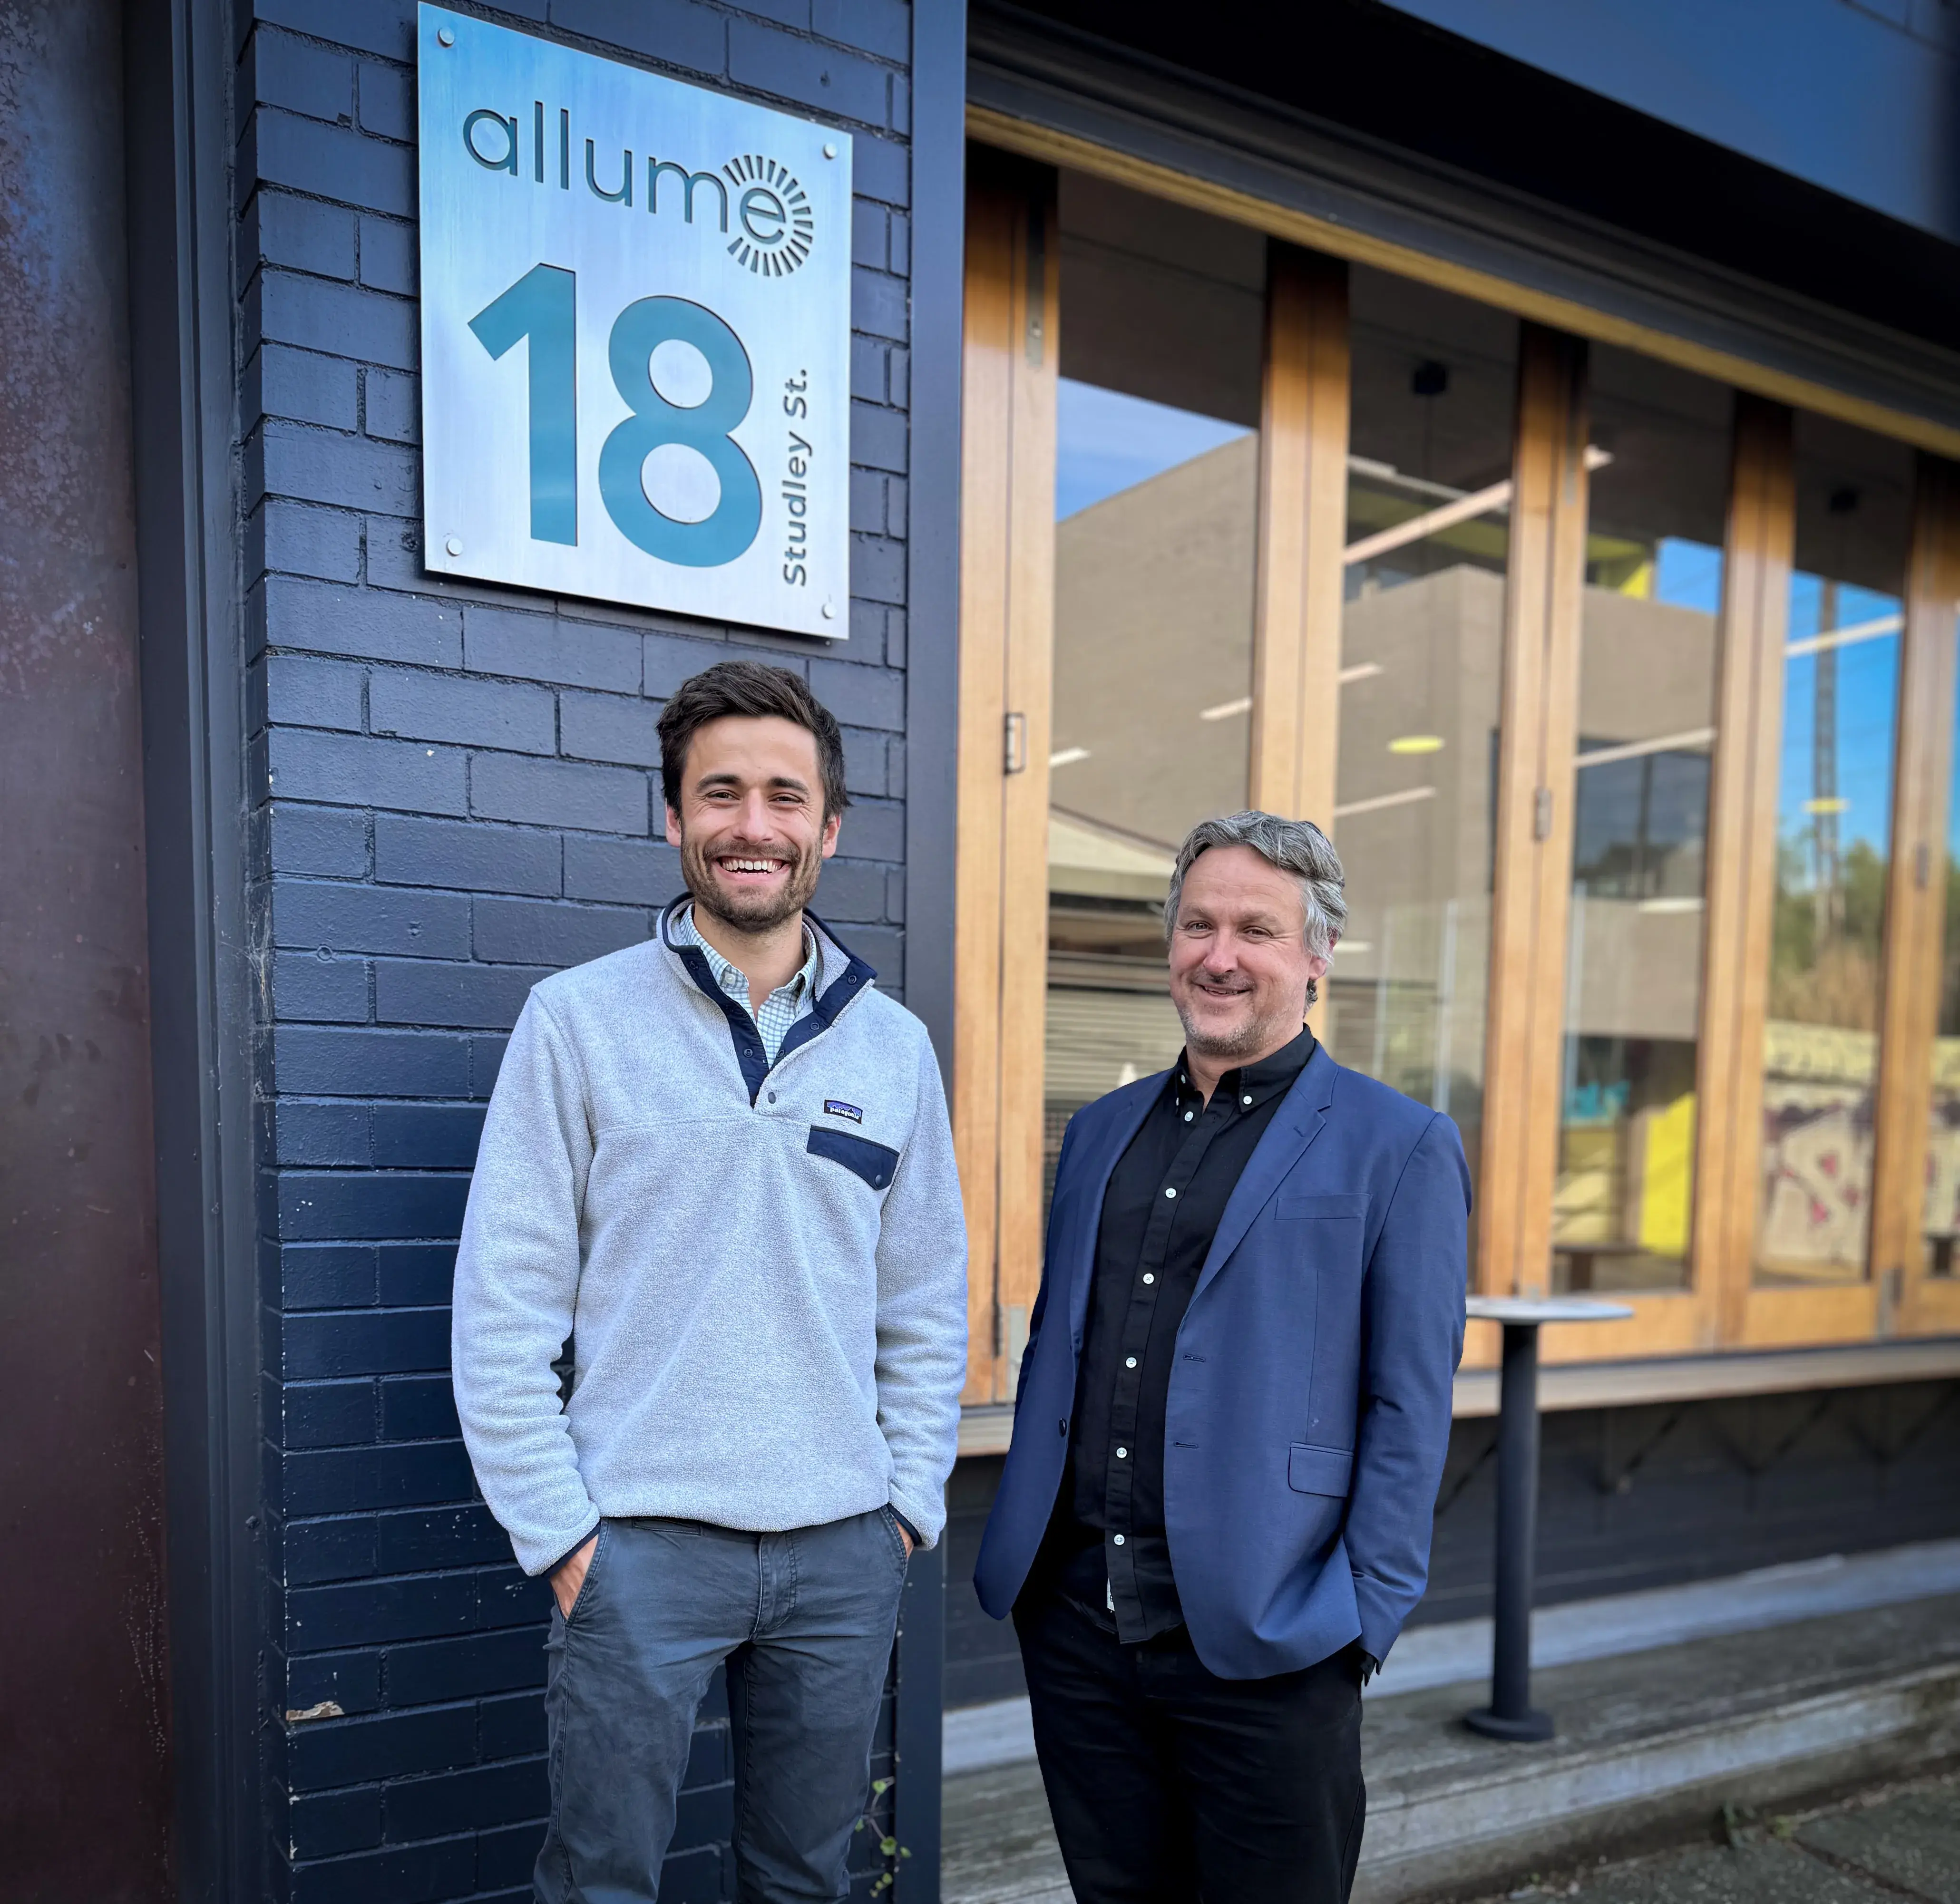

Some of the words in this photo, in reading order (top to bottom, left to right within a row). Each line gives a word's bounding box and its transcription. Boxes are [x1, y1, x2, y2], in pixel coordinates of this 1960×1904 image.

[463, 101, 787, 244] allume
[467, 263, 762, 568] 18
[783, 369, 808, 419] St.
[782, 431, 813, 587] Studley
